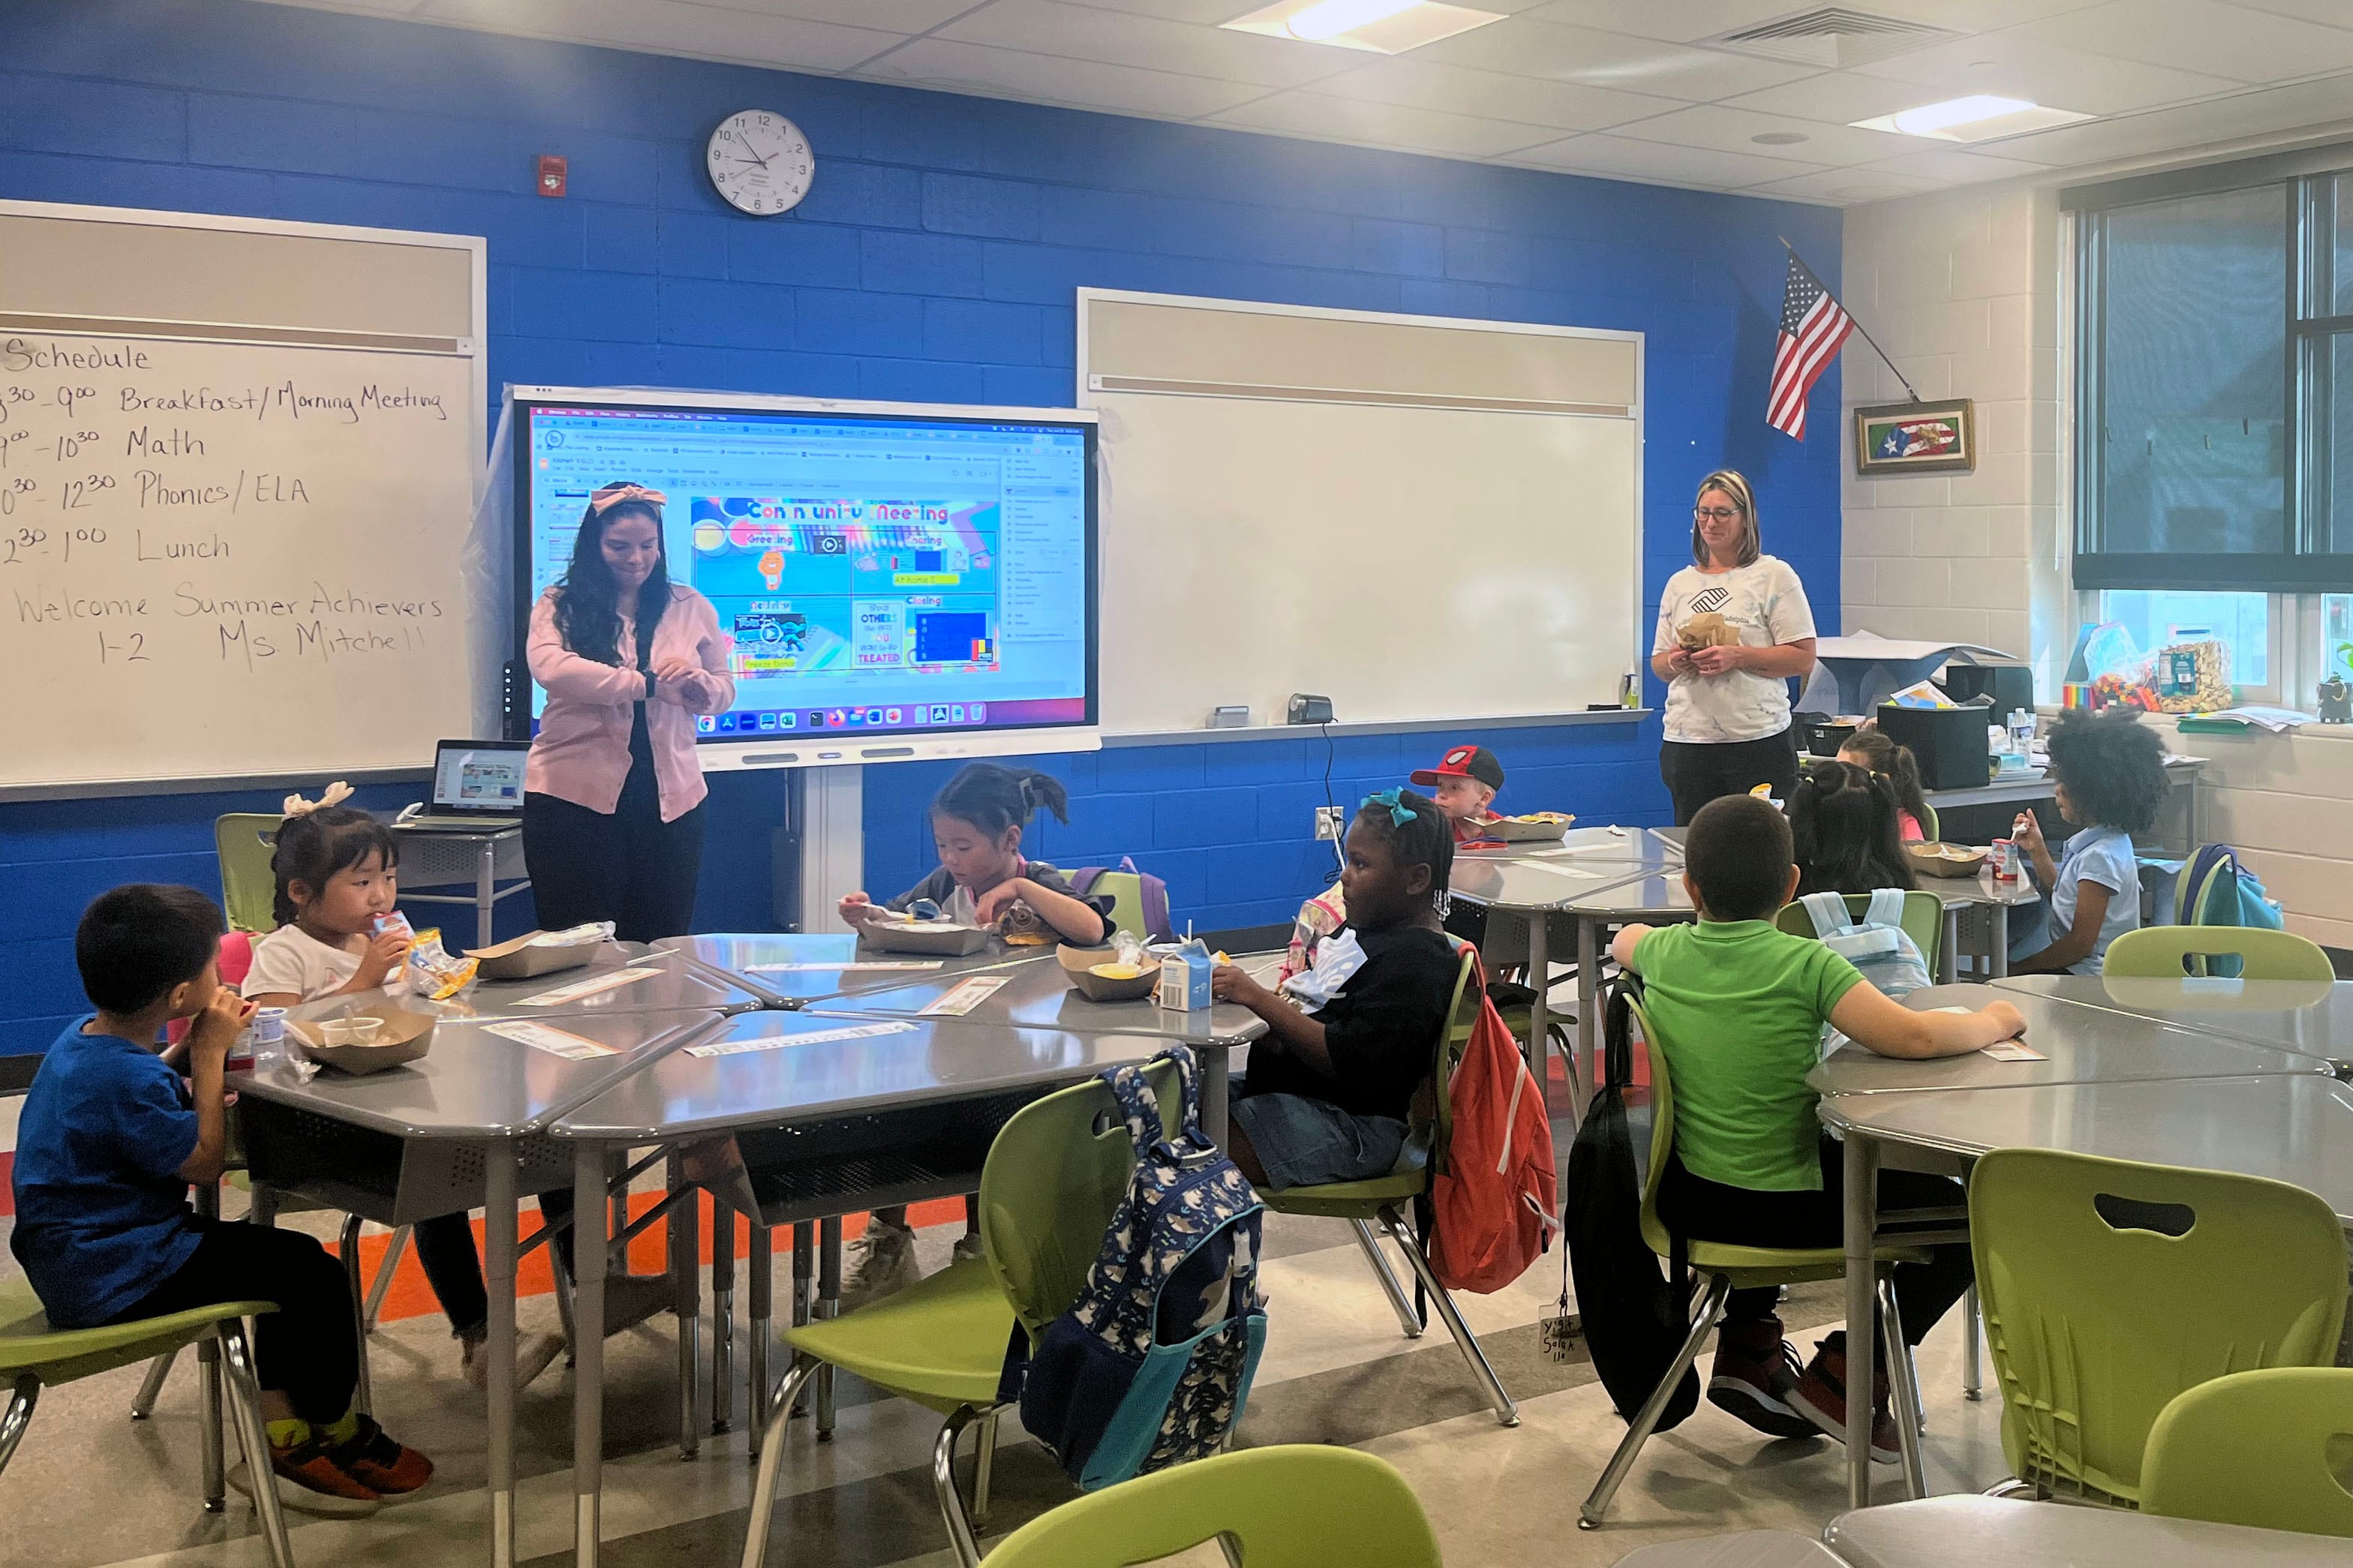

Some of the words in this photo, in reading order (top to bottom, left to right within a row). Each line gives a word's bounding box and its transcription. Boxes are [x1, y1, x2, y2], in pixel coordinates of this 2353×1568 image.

[734, 117, 746, 128] 11
[758, 115, 771, 126] 12
[719, 130, 731, 141] 10
[782, 125, 786, 135] 1
[795, 143, 803, 154] 2
[714, 149, 721, 160] 9
[798, 165, 806, 175] 3
[717, 173, 726, 182] 8
[792, 185, 798, 195] 4
[732, 191, 740, 201] 7
[753, 200, 762, 209] 6
[776, 199, 783, 209] 5
[5, 338, 154, 372] Schedule
[362, 384, 448, 421] Meeting
[127, 426, 205, 458] Math
[748, 502, 863, 524] Community
[870, 504, 948, 525] Meeting
[138, 529, 230, 562] Lunch
[14, 583, 149, 624] Welcome
[173, 581, 298, 619] Summer
[309, 581, 443, 618] Achievers
[906, 596, 941, 607] Closing
[861, 614, 897, 623] OTHERS
[296, 621, 425, 664] Mitchell
[858, 653, 900, 663] TREATED
